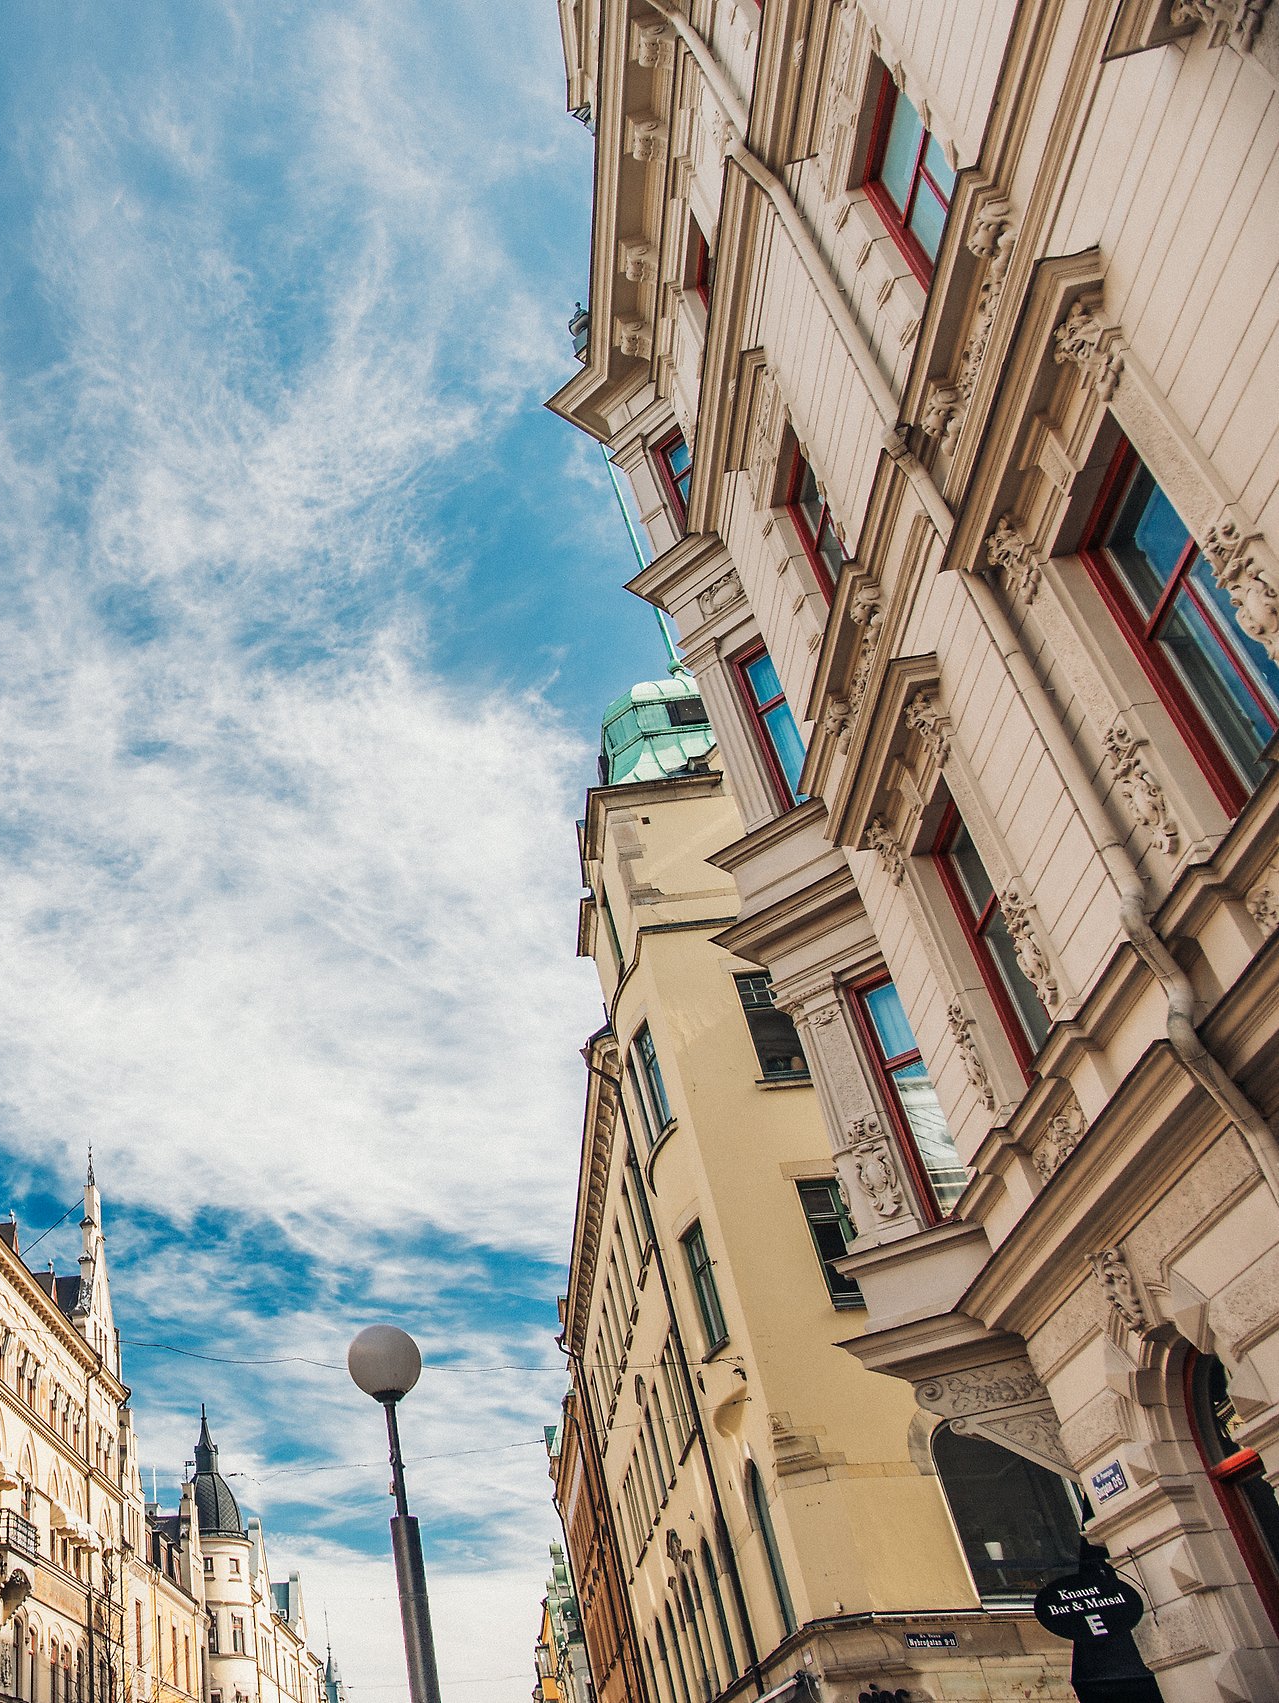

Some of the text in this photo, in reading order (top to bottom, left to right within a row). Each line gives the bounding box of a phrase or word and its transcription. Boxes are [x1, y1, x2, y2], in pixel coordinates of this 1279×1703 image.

[1058, 1586, 1100, 1600] Knaust
[1048, 1593, 1126, 1615] Bar & Matsal
[908, 1639, 943, 1647] Nybrogatan
